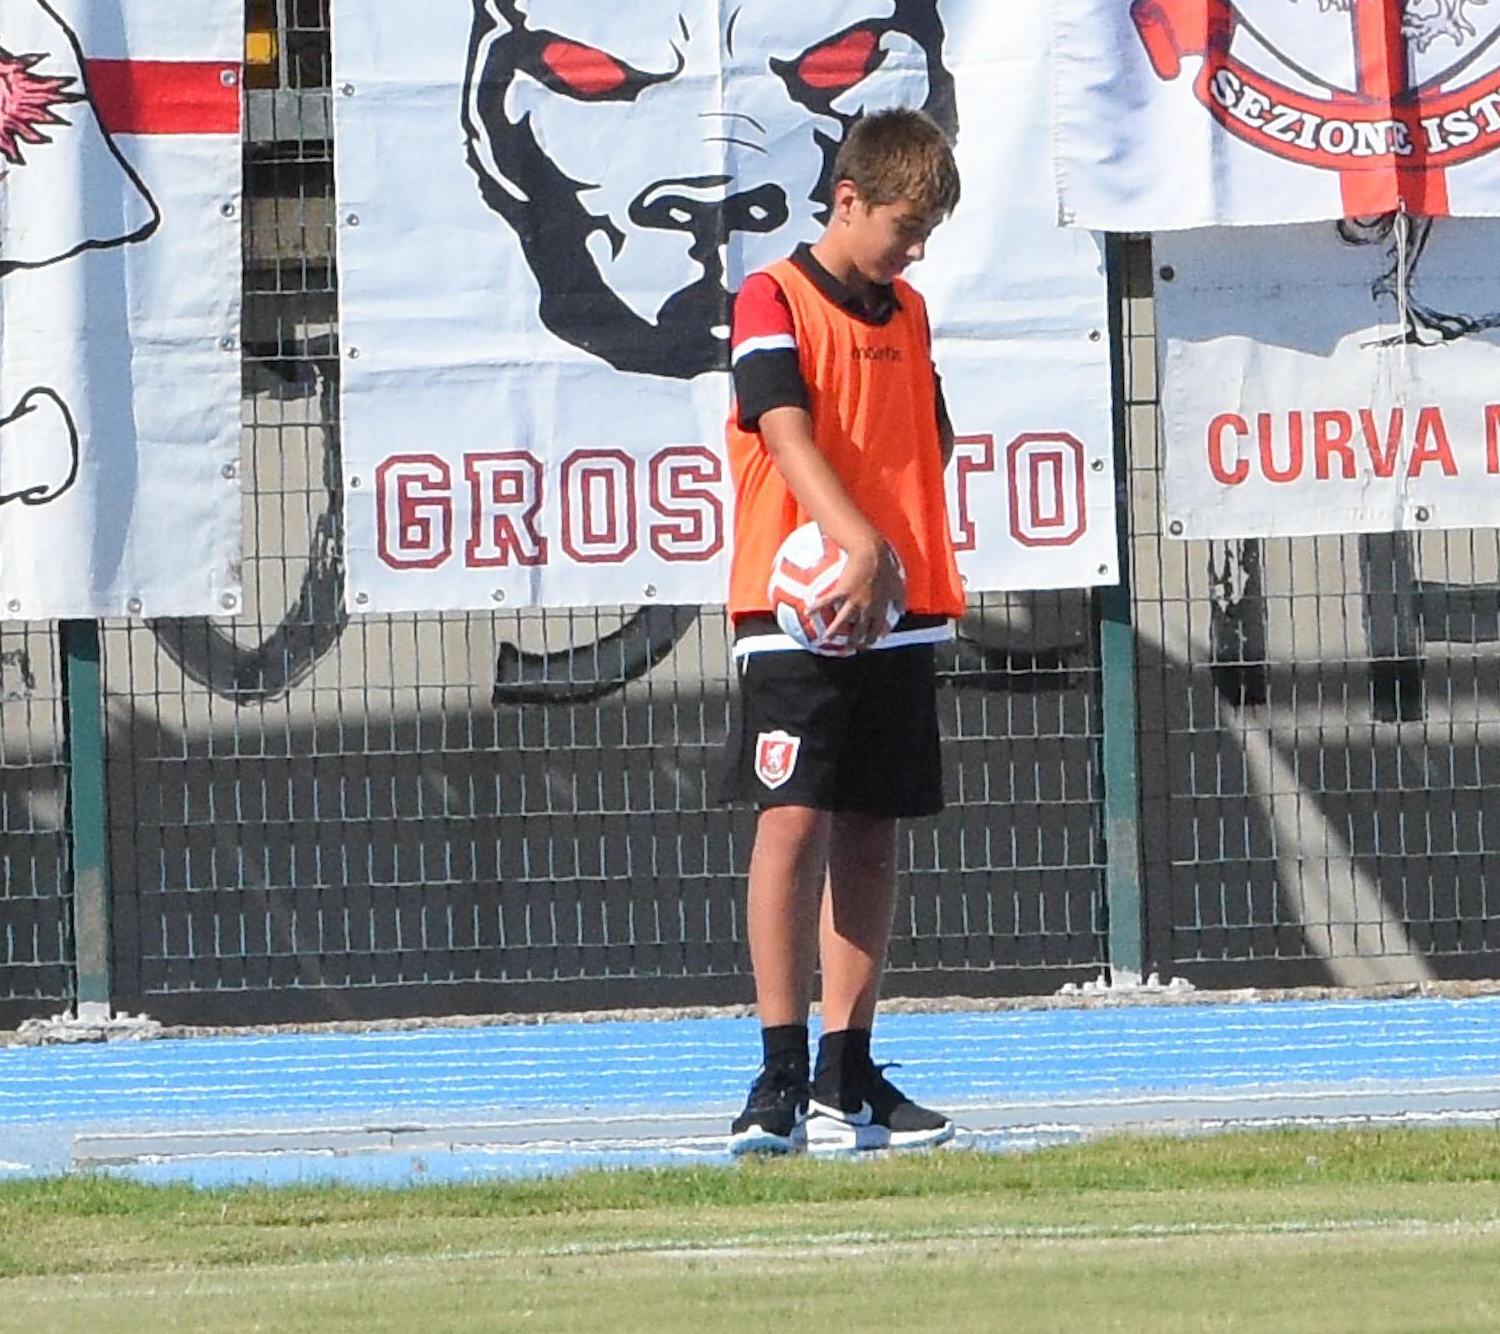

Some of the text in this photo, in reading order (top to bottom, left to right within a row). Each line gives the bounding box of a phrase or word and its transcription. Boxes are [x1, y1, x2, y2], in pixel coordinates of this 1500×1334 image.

[1209, 67, 1416, 157] SEZIONE
[1205, 406, 1460, 486] CURVA
[375, 431, 1088, 570] GROSTO
